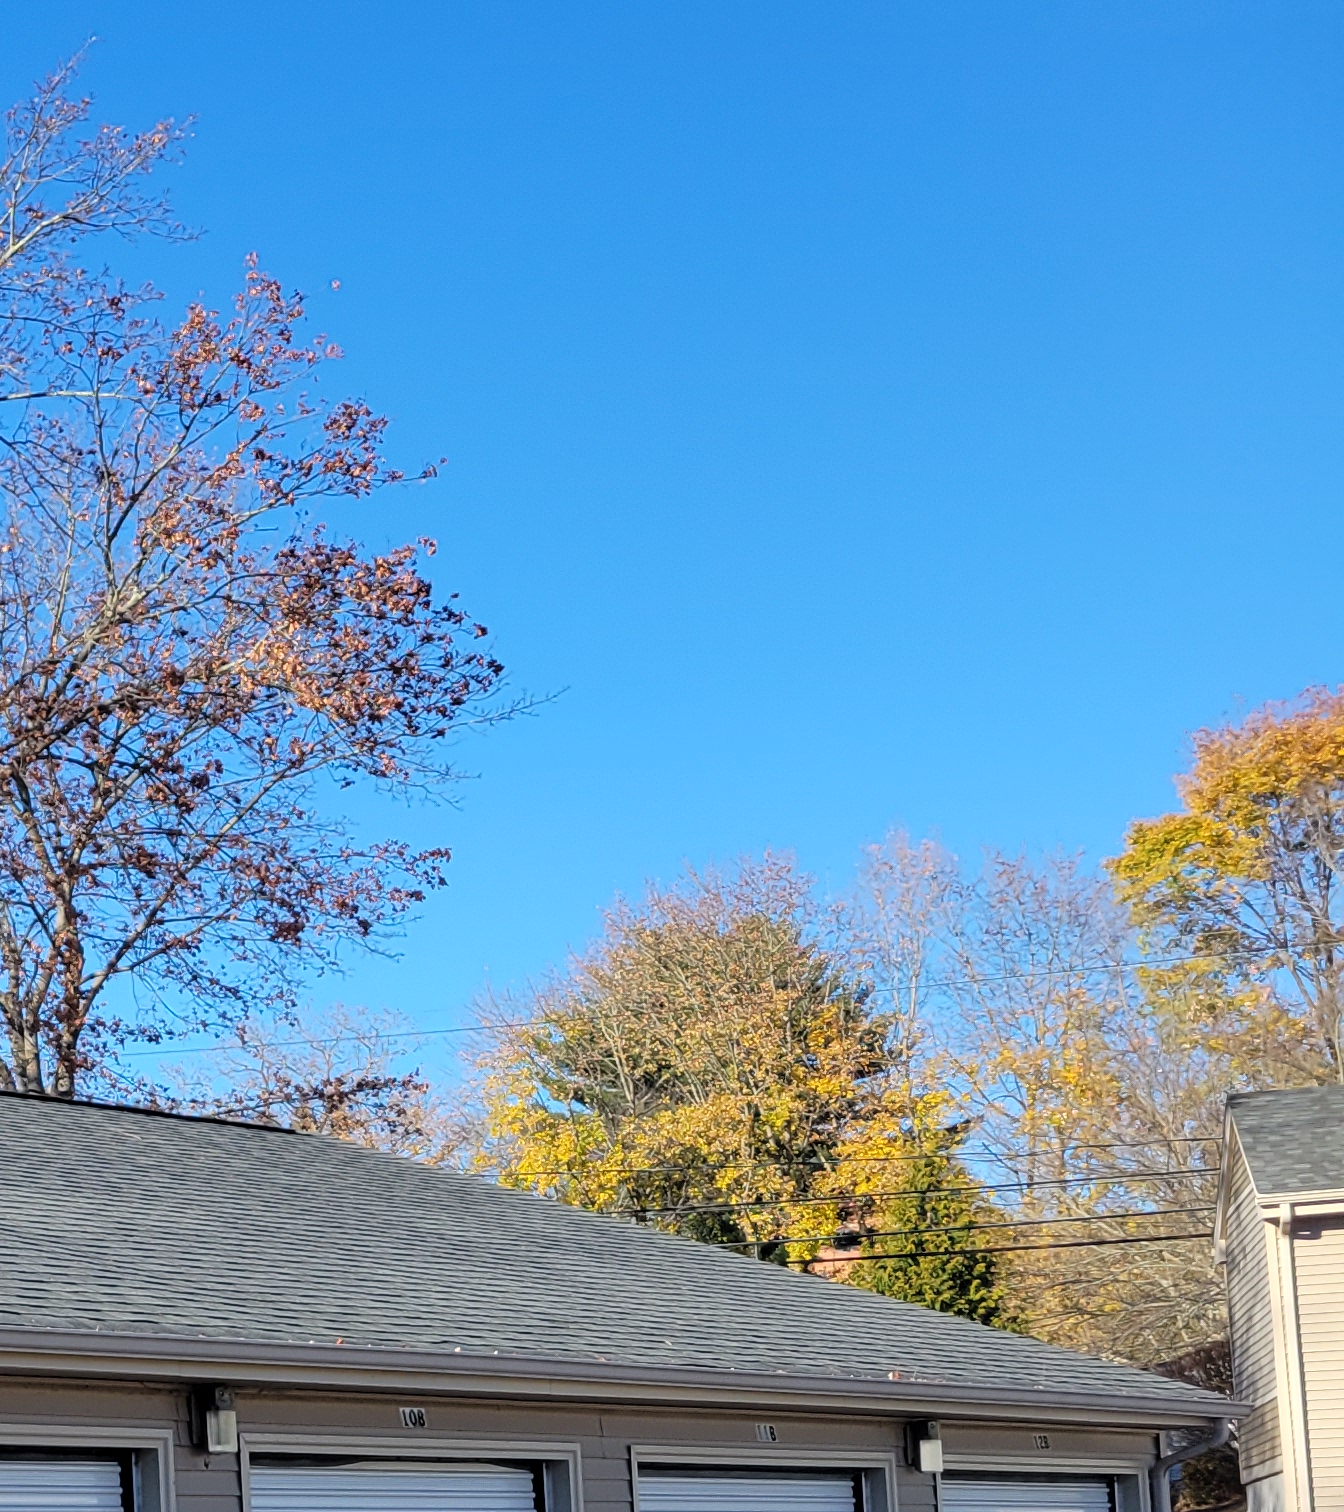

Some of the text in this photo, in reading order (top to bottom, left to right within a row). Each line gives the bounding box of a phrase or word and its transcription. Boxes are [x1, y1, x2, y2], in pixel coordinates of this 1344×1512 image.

[402, 1409, 426, 1426] 10B
[757, 1425, 777, 1441] 11B
[1033, 1435, 1050, 1449] 12B
